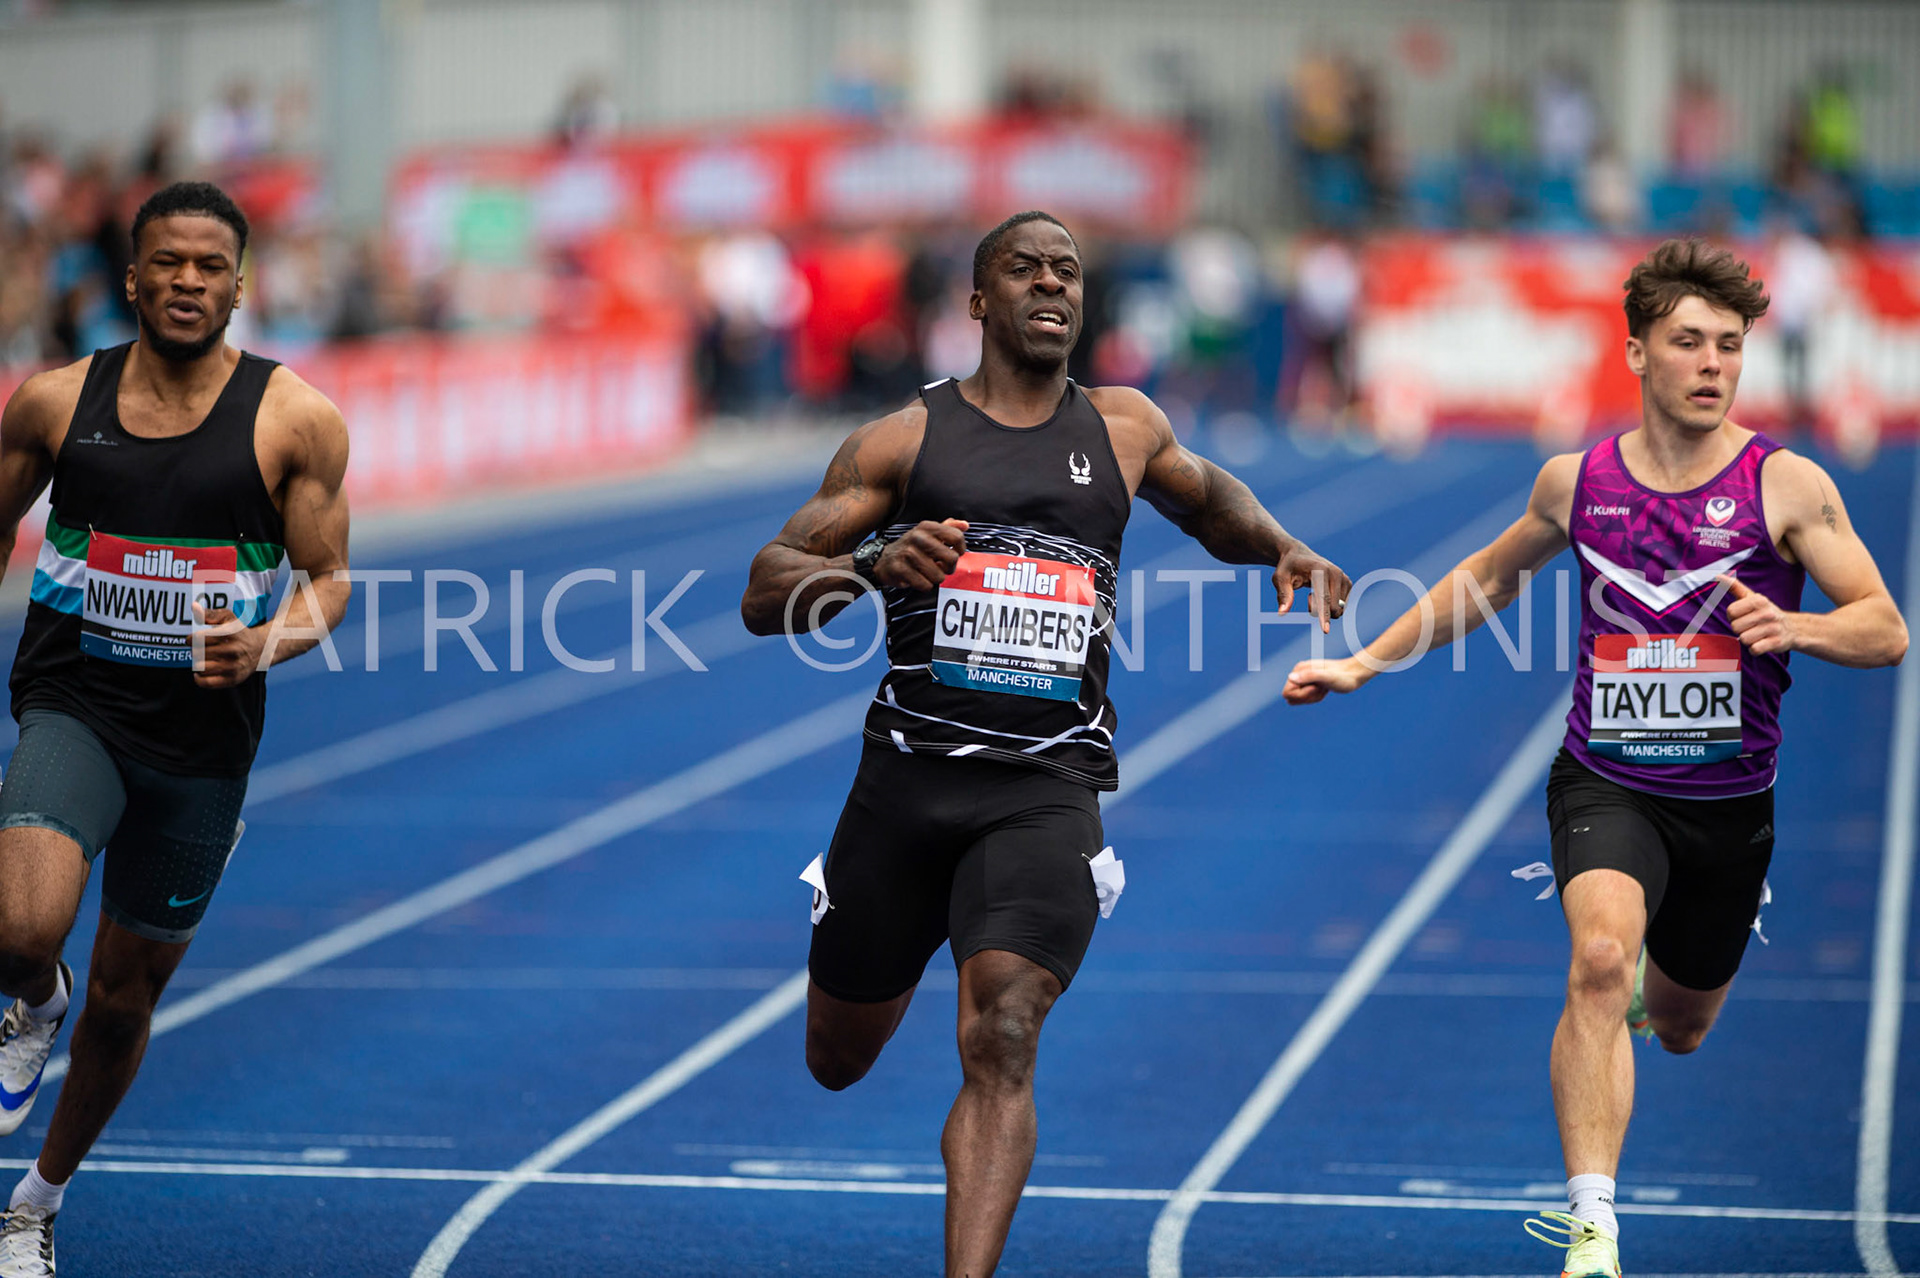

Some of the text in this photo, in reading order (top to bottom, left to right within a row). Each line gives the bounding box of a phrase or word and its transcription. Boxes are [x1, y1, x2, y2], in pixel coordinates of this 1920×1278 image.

[1593, 505, 1630, 516] KUKRI
[1698, 539, 1731, 549] ATHLETICS
[123, 549, 198, 580] müller
[982, 562, 1060, 597] müller
[941, 598, 1086, 653] CHAMBERS
[111, 631, 150, 642] #WHERE
[112, 644, 192, 661] MANCHESTER
[1626, 638, 1700, 669] müller
[967, 654, 1057, 671] #WHERE IT STARTS
[967, 669, 1053, 690] MANCHESTER
[1597, 682, 1734, 719] TAYLOR
[1620, 731, 1661, 739] #WHERE
[1671, 731, 1709, 739] STARTS
[1622, 745, 1705, 756] MANCHESTER
